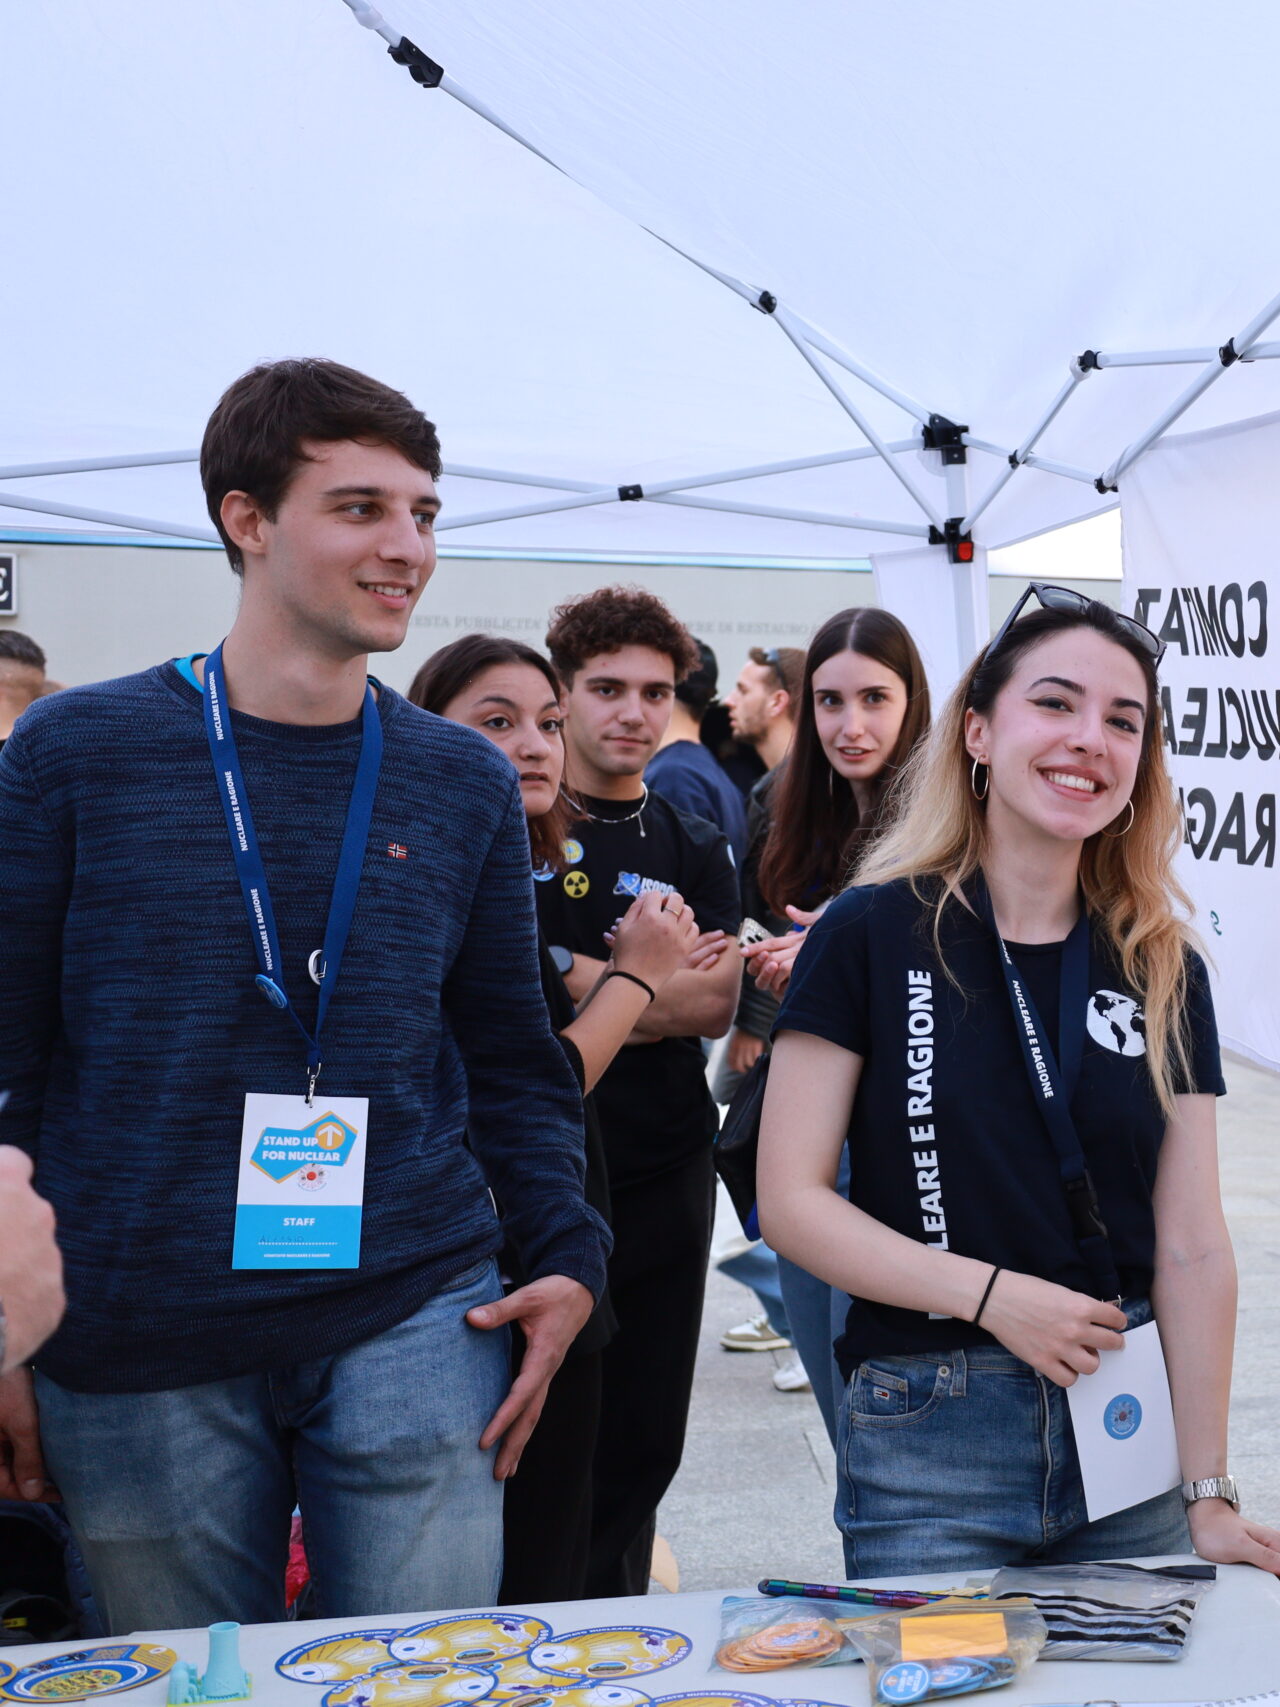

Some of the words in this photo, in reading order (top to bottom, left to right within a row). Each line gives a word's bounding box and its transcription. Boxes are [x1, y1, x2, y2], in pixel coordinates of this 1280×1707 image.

[209, 671, 217, 699] RAGIONE
[212, 704, 224, 740] NUCLEARE
[224, 771, 238, 806] RAGIONE
[234, 812, 248, 851] NUCLEARE
[250, 888, 264, 924] RAGIONE
[260, 930, 273, 970] NUCLEARE
[1012, 980, 1036, 1036] NUCLEARE
[908, 970, 934, 1116] RAGIONE
[1028, 1037, 1039, 1046] E
[1031, 1047, 1054, 1099] RAGIONE
[263, 1136, 299, 1146] STAND
[303, 1137, 318, 1147] UP
[909, 1123, 935, 1142] E
[262, 1151, 286, 1160] FOR
[288, 1152, 340, 1162] NUCLEAR
[283, 1218, 316, 1226] STAFF
